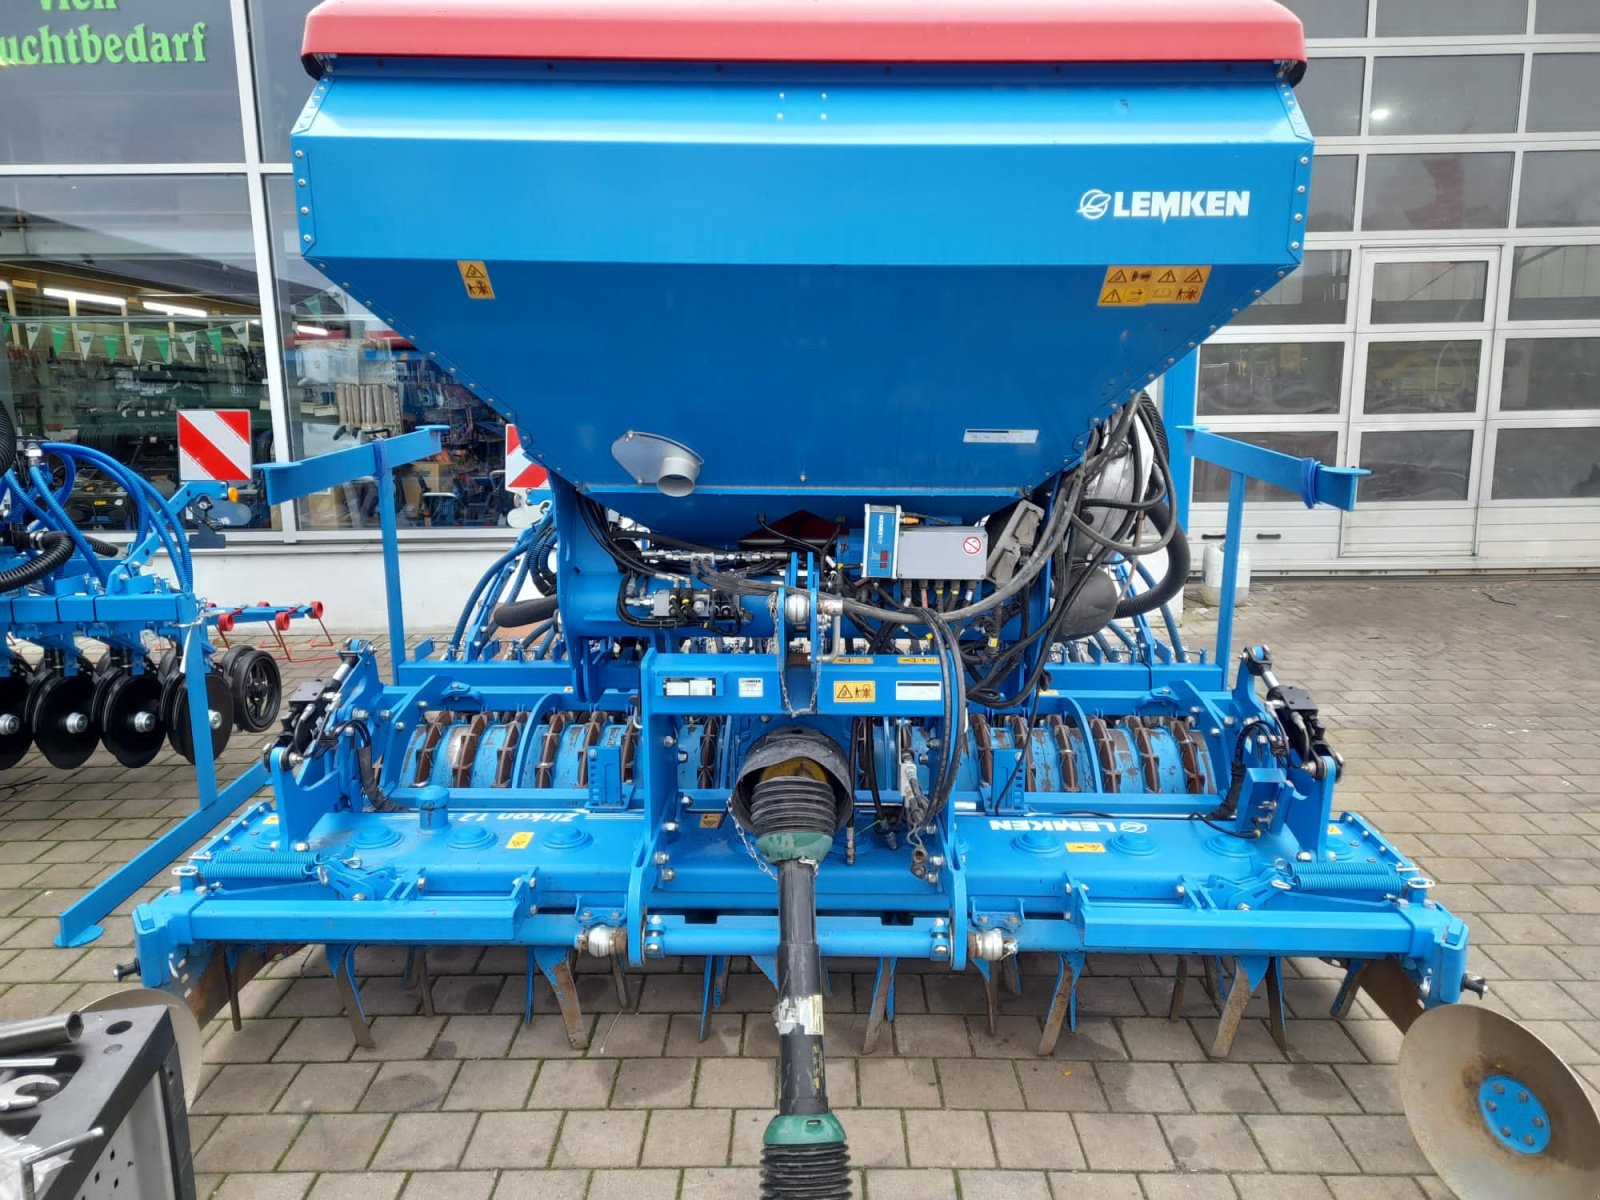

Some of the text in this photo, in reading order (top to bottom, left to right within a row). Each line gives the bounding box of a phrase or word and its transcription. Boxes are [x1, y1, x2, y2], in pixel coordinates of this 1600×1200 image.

[1113, 190, 1250, 224] LEMKEN
[458, 812, 580, 822] Zirkon 12
[989, 819, 1118, 832] LEMKEN
